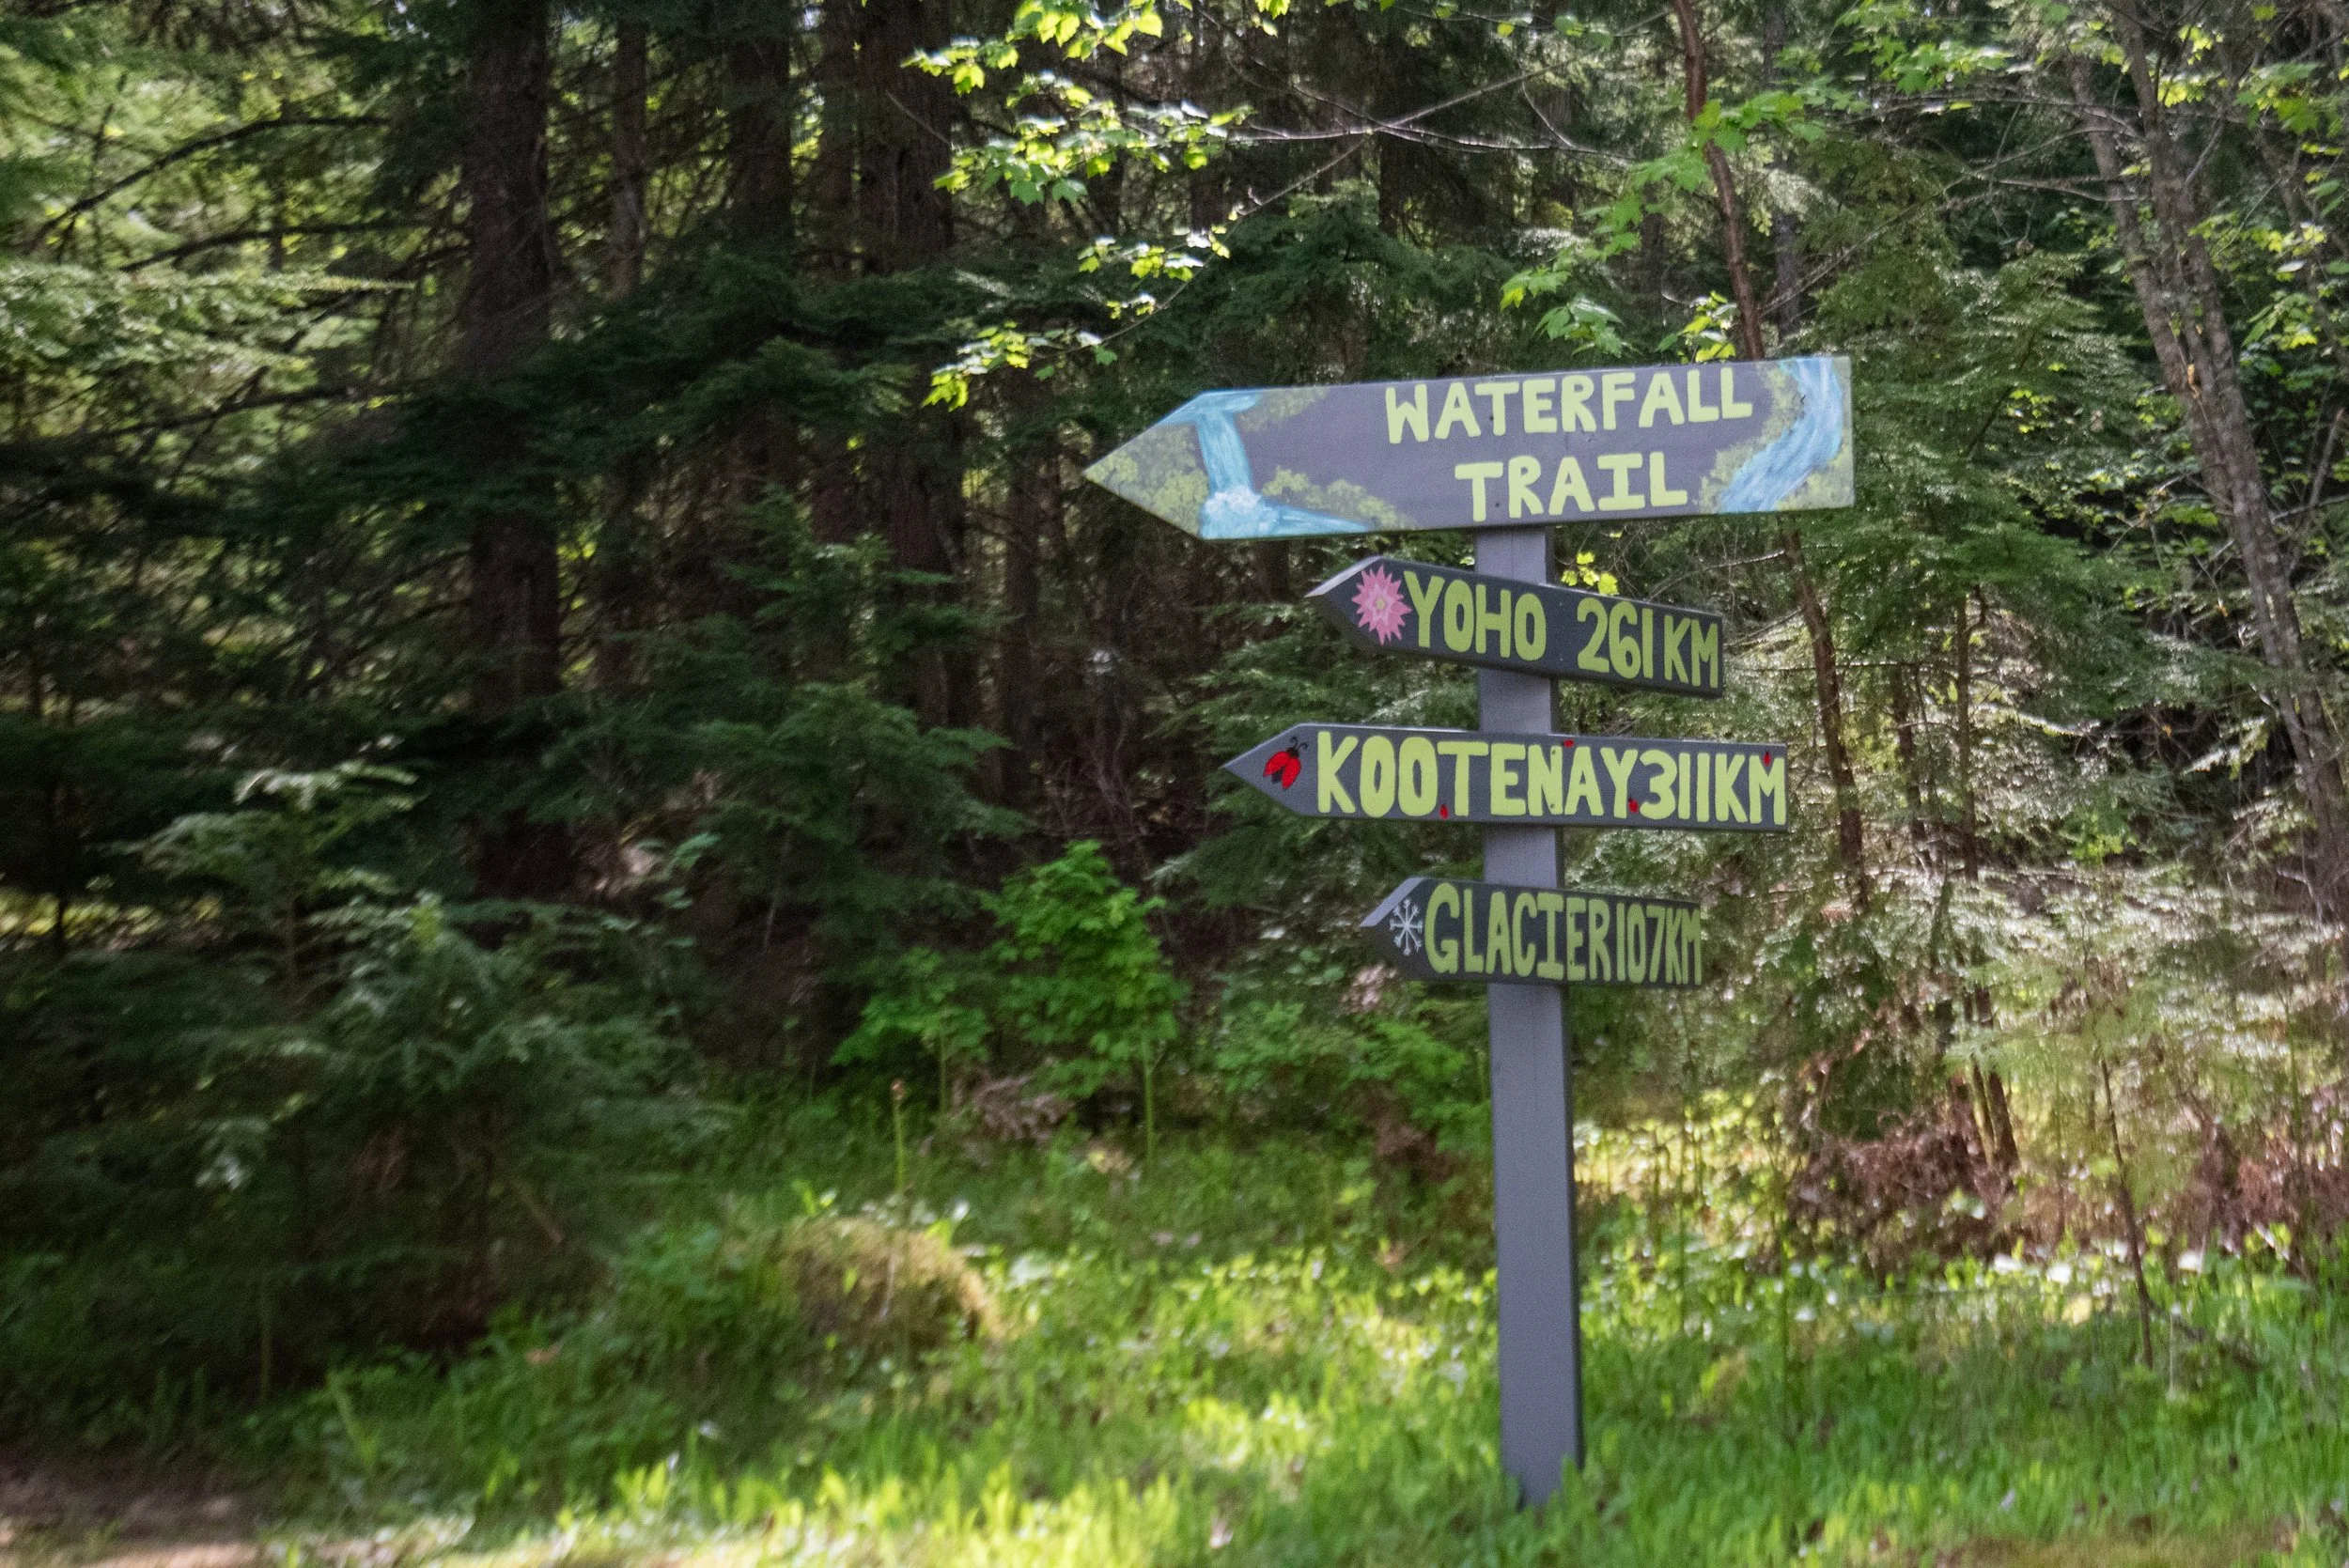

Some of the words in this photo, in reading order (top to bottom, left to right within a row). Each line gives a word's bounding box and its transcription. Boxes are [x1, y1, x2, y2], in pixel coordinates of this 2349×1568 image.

[1385, 367, 1752, 443] WATERFALL
[1455, 452, 1688, 522] TRAIL
[1404, 570, 1547, 660] YOHO
[1317, 731, 1638, 818] KOOTENAY
[1424, 882, 1611, 981] GLACIER
